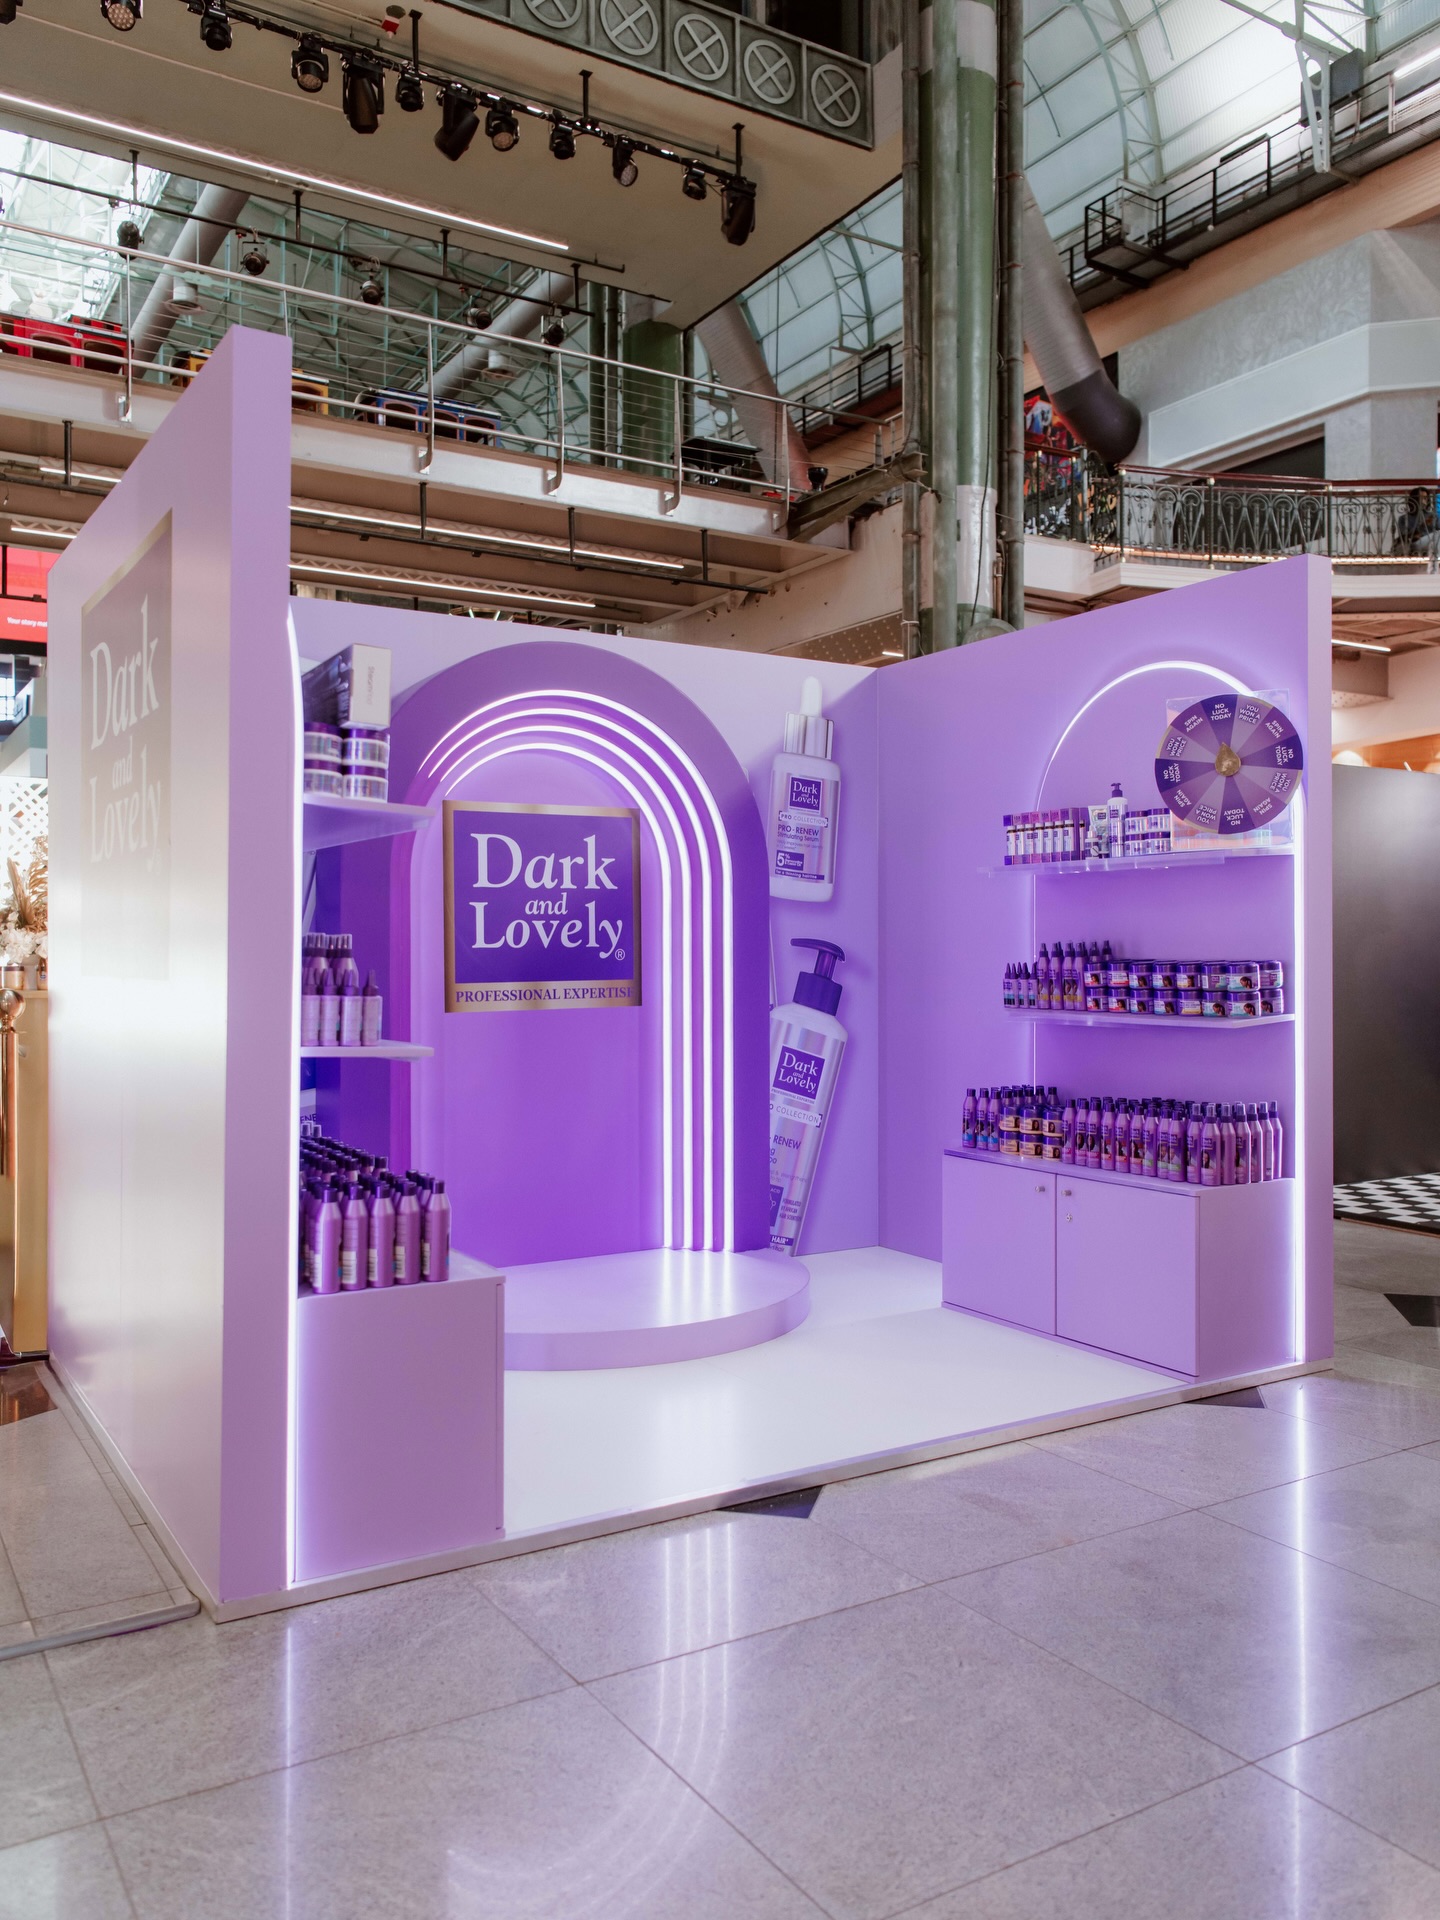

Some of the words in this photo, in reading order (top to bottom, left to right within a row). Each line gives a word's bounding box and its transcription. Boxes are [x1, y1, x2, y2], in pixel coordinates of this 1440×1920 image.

[90, 594, 159, 750] Dark
[1240, 709, 1254, 717] WON
[1184, 715, 1198, 726] SPIN
[1186, 717, 1203, 732] AGAIN
[1272, 720, 1284, 733] SPIN
[1265, 722, 1281, 739] AGAIN
[1166, 738, 1175, 751] YOU
[1170, 742, 1180, 756] WON
[1288, 749, 1294, 758] NO
[112, 735, 132, 790] and
[1163, 770, 1169, 779] NO
[1278, 773, 1287, 787] WON
[793, 781, 818, 795] Dark
[1282, 779, 1292, 792] YOU
[792, 792, 818, 807] Lovely
[1174, 795, 1185, 808] SPIN
[1177, 789, 1192, 806] AGAIN
[1253, 797, 1271, 812] AGAIN
[90, 744, 161, 873] Lovely
[1201, 811, 1216, 820] WON
[793, 815, 826, 825] COLLECTION
[1197, 816, 1210, 824] YOU
[778, 824, 791, 832] PRO
[795, 827, 819, 836] RENEW
[470, 833, 618, 890] Dark
[525, 892, 568, 915] and
[456, 988, 560, 1002] PROFESSIONAL
[782, 1052, 818, 1076] Dark
[778, 1068, 816, 1093] Lovely
[776, 1106, 818, 1123] COLLECTION
[773, 1134, 801, 1150] RENEW
